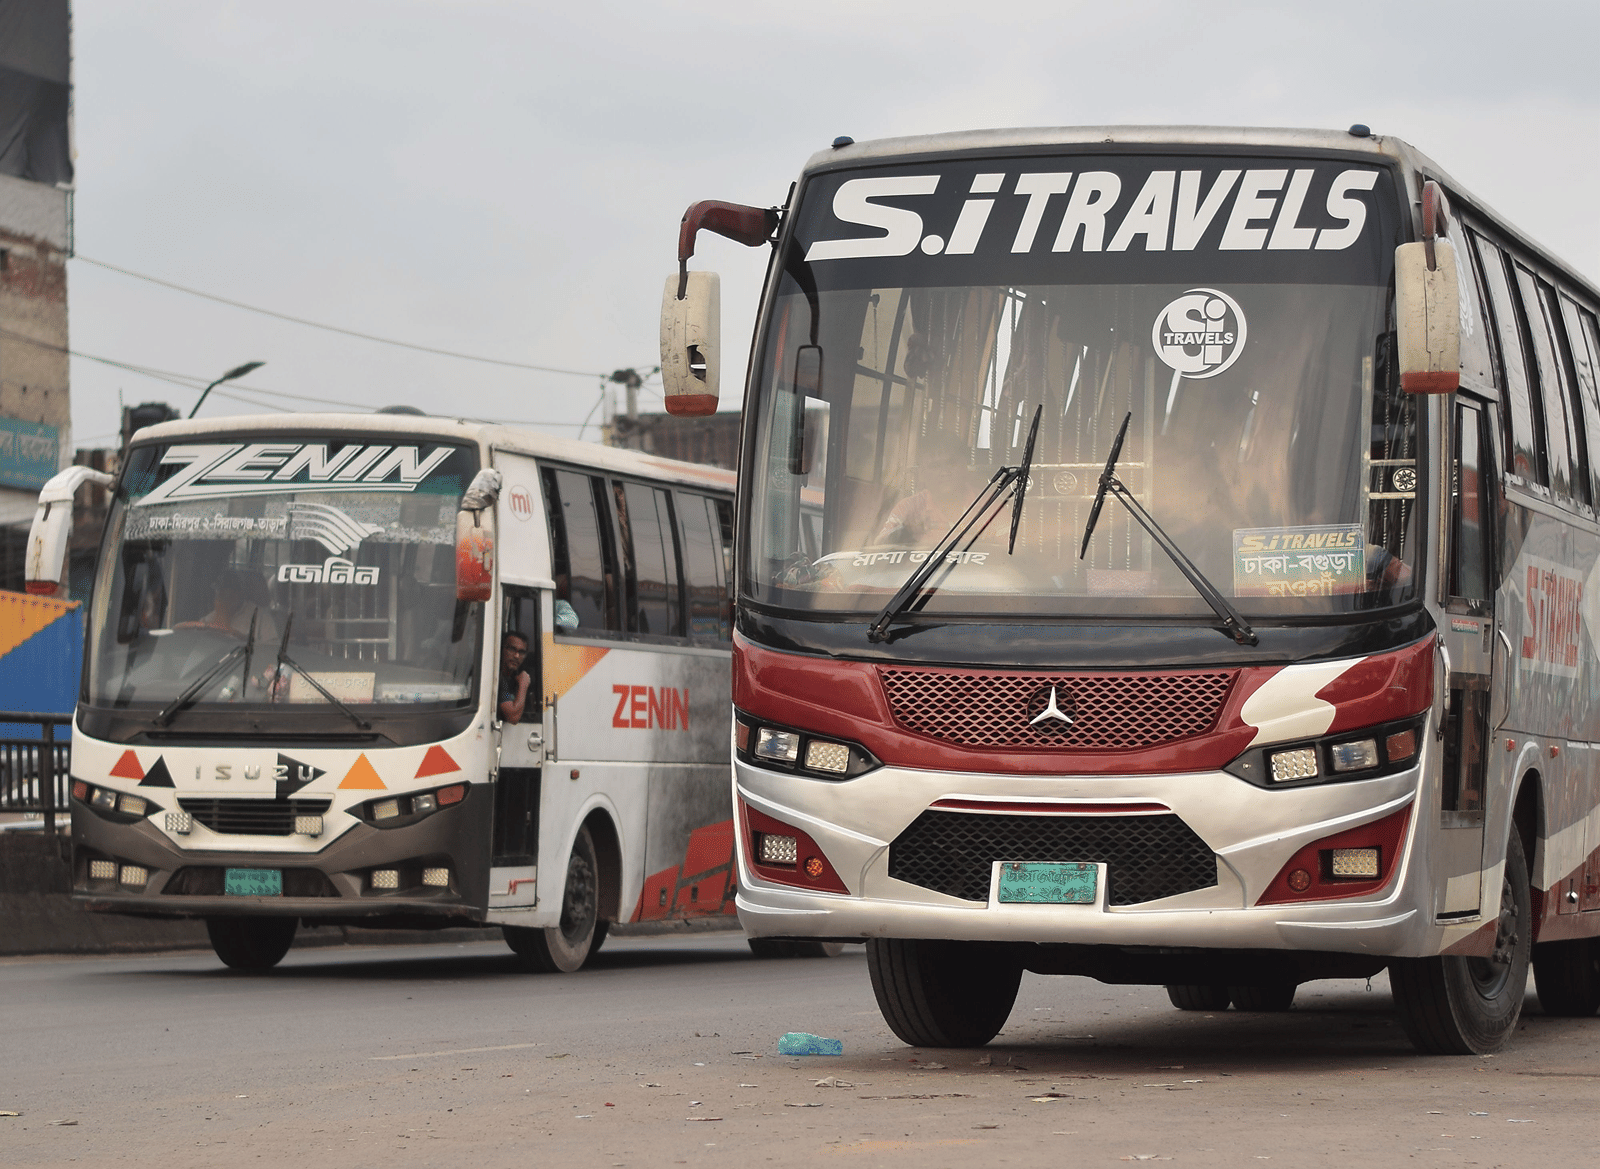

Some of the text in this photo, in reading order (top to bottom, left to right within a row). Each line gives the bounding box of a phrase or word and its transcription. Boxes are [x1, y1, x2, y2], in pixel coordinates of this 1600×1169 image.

[1011, 169, 1379, 254] TRAVELS
[1163, 332, 1234, 345] TRAVELS
[134, 443, 456, 506] ZENIN
[1282, 531, 1358, 550] TRAVELS
[277, 556, 380, 585] জেনিন
[1241, 552, 1355, 575] ঢাকা-বগুড়া
[612, 684, 690, 732] ZENIN
[195, 764, 315, 782] ISUZU
